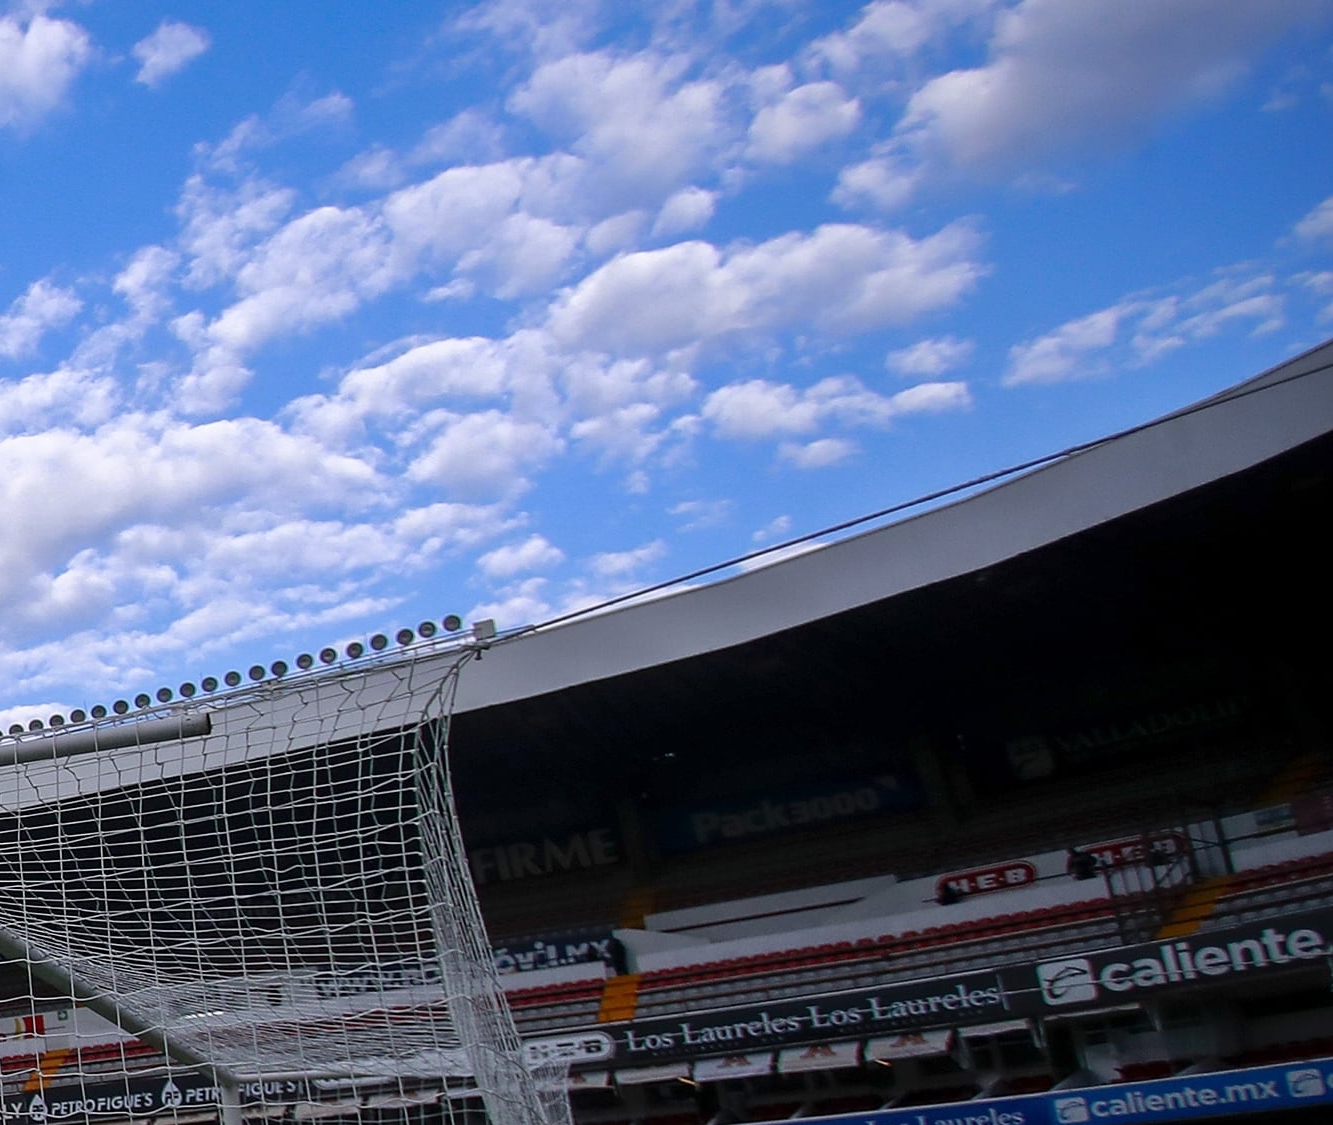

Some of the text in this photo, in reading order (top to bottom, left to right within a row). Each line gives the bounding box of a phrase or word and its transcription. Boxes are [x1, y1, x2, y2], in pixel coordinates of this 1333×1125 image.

[472, 829, 621, 884] FIRME
[806, 1004, 862, 1030] Los
[867, 983, 1001, 1021] Laureles
[626, 1029, 673, 1051] Los
[679, 1011, 801, 1044] Laureles
[185, 1086, 222, 1103] PETR
[1091, 1079, 1281, 1119] caliente.mx
